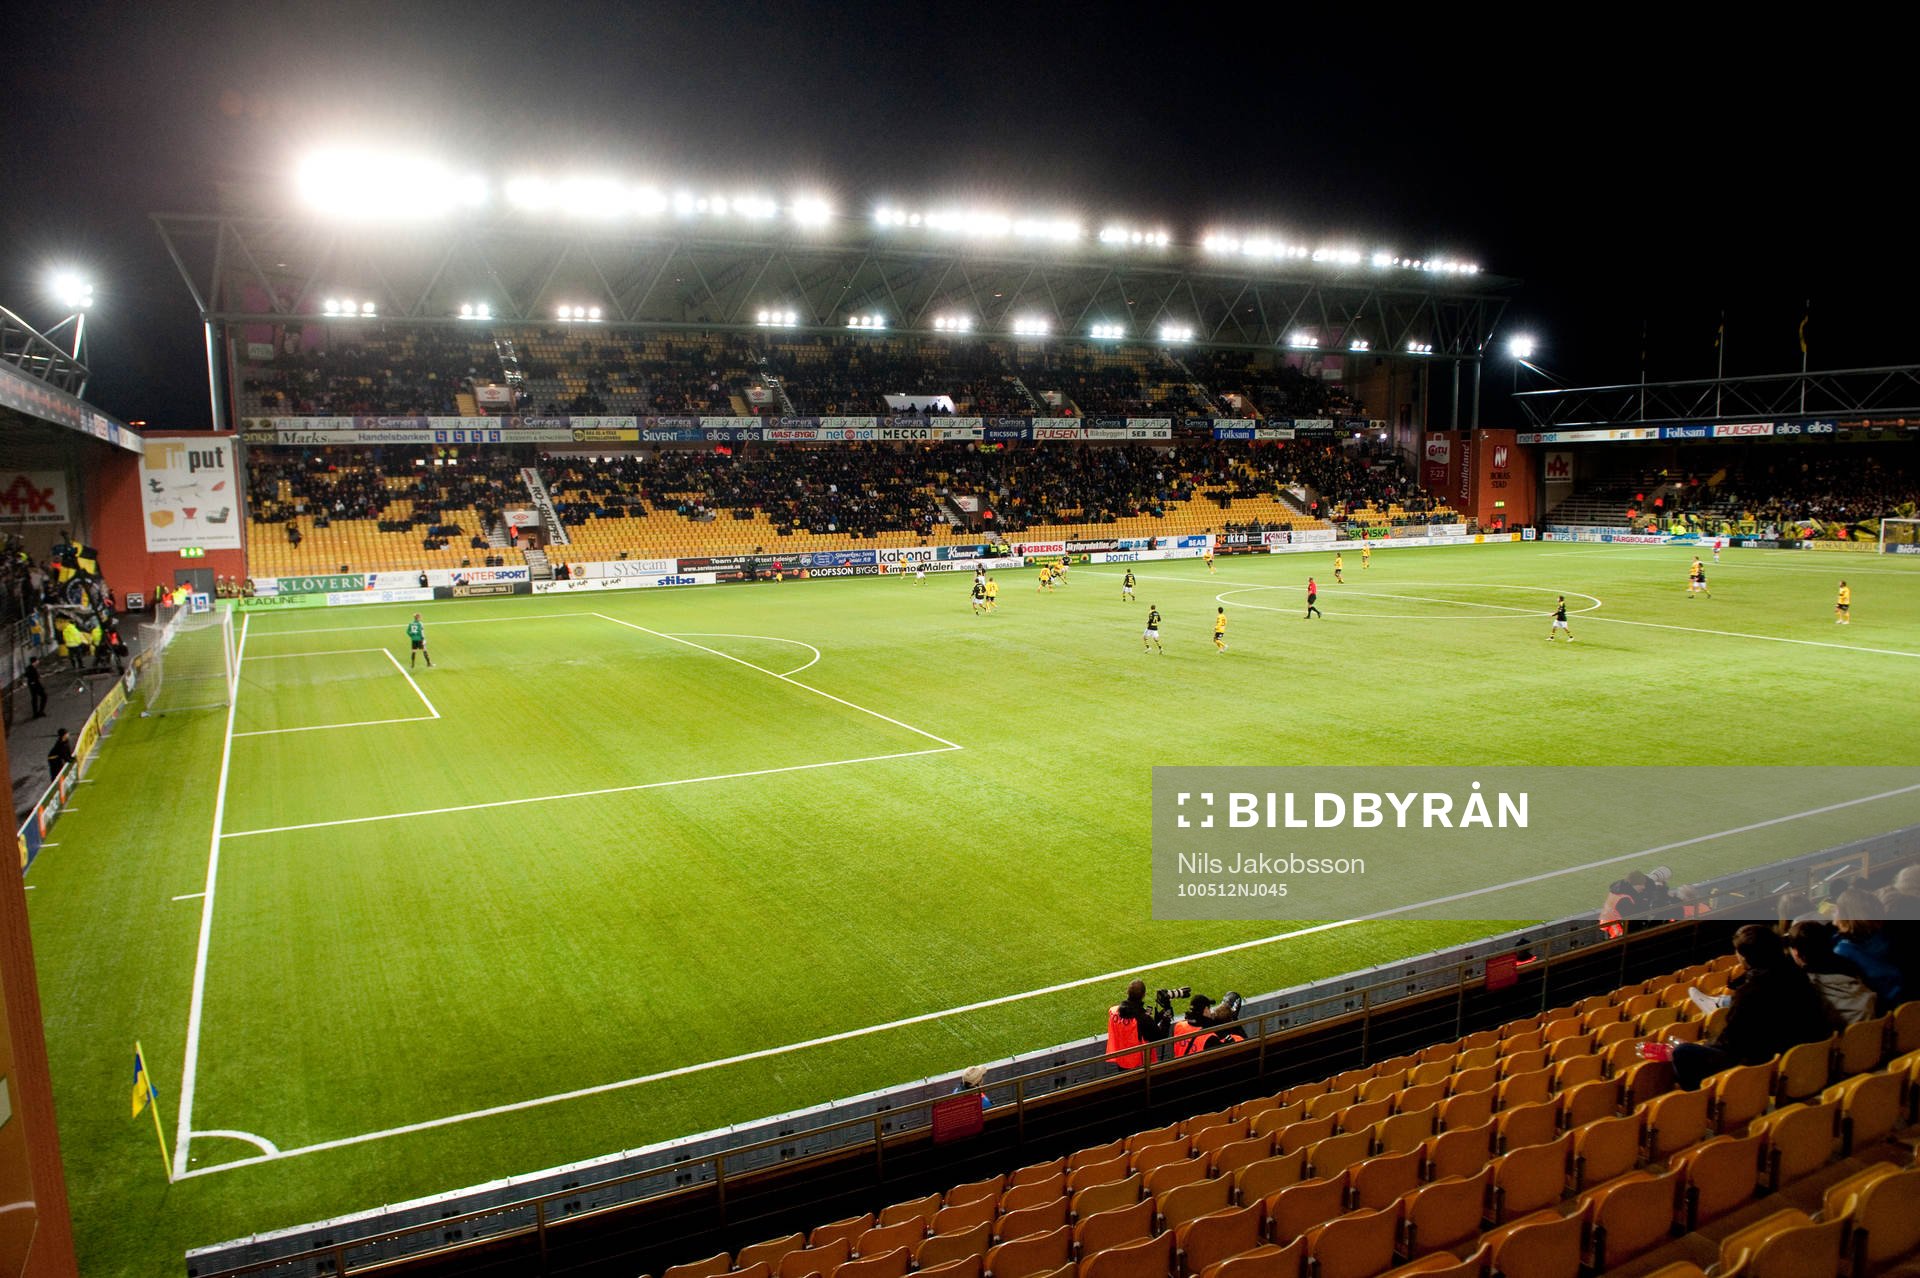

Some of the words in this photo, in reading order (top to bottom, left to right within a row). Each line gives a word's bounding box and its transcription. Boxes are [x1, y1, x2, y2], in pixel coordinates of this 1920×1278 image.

[643, 430, 678, 441] SILVENT
[883, 430, 927, 438] MECKA
[989, 430, 1018, 438] ERICSSON
[1036, 430, 1078, 439] PULSEN
[1131, 430, 1147, 438] SEB
[1152, 430, 1168, 438] SEB
[1219, 430, 1250, 439] Folksam
[1666, 426, 1707, 439] Folksam
[1716, 424, 1769, 436] PULSEN
[282, 433, 328, 444] Marks
[358, 432, 431, 442] Handelsbanken
[188, 446, 224, 473] put
[1349, 527, 1389, 539] SKNSKA
[879, 549, 932, 563] kabona
[463, 570, 527, 582] INTERSPORT
[810, 567, 854, 577] OLOFSSON
[855, 565, 878, 575] BYGG
[279, 577, 365, 592] KLÖVERN
[657, 575, 696, 585] stiba
